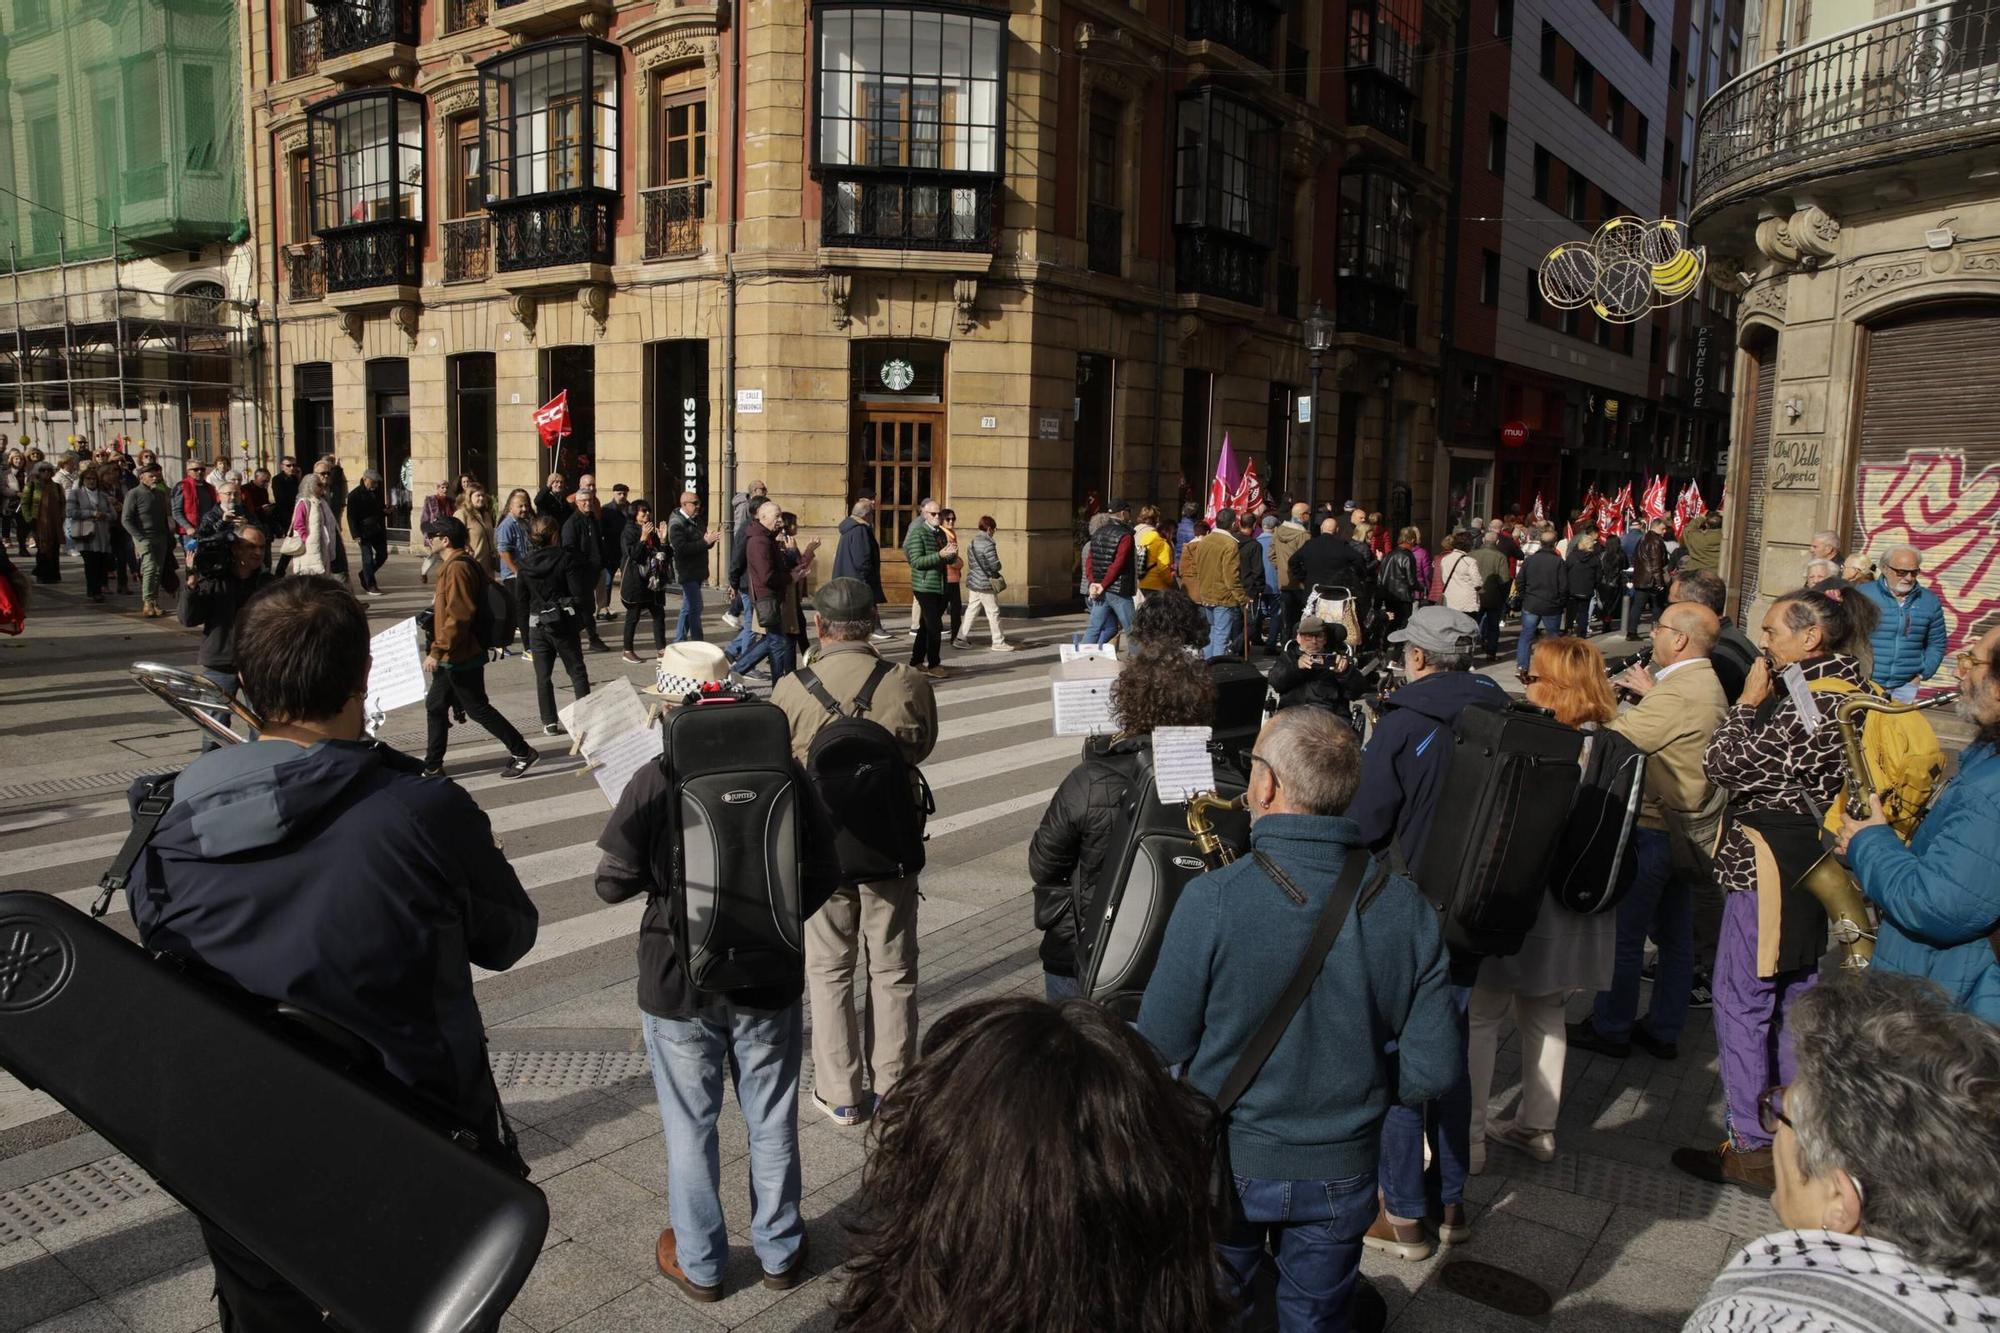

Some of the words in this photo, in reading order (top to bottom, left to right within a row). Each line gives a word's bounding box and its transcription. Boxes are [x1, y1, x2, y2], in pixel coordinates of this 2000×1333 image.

[1693, 327, 1708, 407] PENELOPE
[684, 397, 697, 494] RBUCKS
[1504, 428, 1524, 437] muu
[1773, 440, 1791, 458] Del
[1790, 441, 1820, 467] Valle
